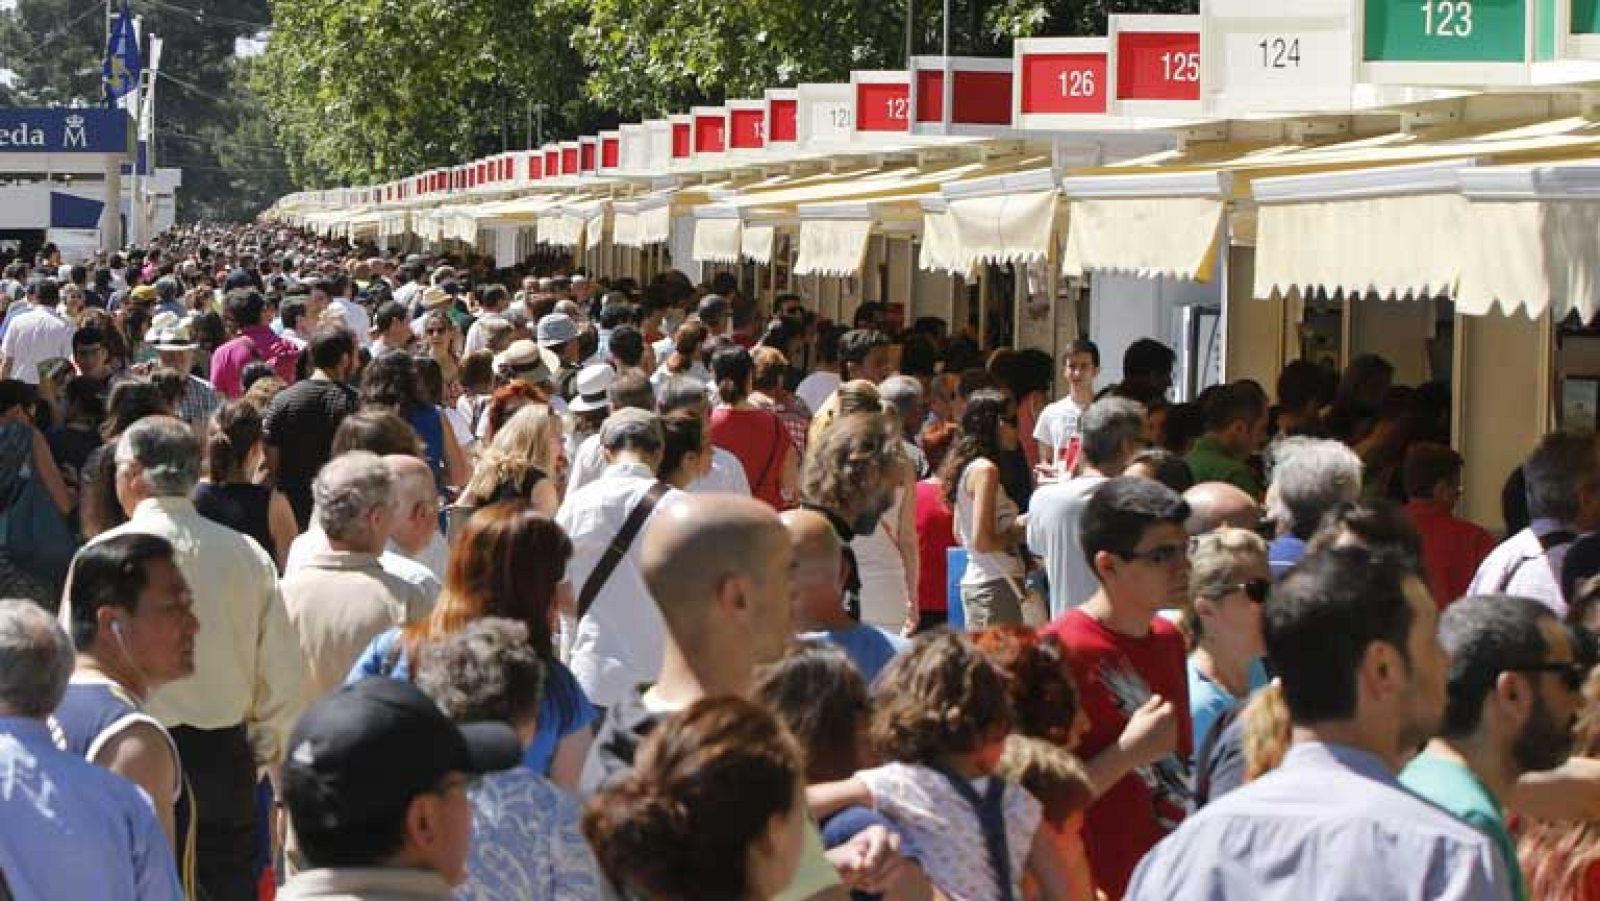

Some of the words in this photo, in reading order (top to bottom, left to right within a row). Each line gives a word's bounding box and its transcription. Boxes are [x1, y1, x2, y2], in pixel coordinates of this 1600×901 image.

[1420, 0, 1472, 36] 123
[1160, 51, 1200, 81] 125
[1259, 38, 1301, 68] 124
[1058, 70, 1095, 97] 126
